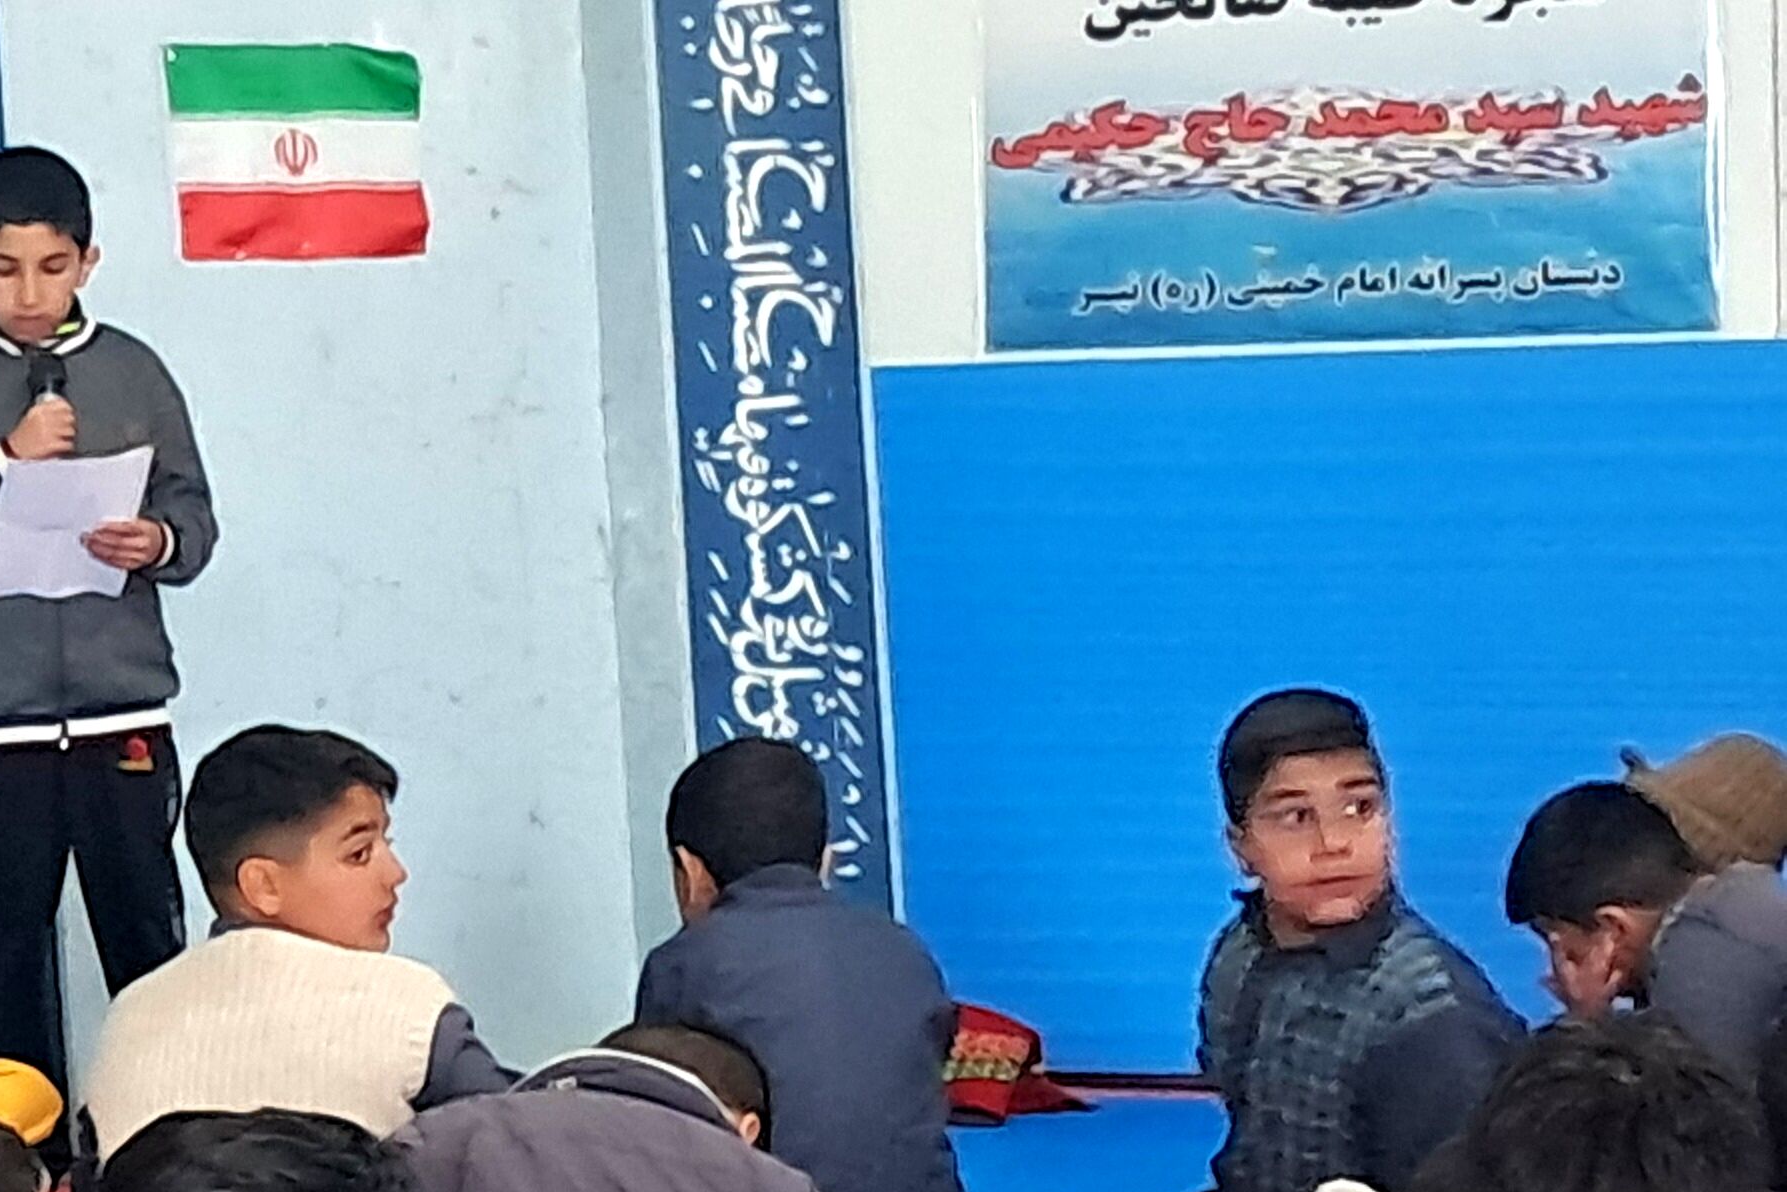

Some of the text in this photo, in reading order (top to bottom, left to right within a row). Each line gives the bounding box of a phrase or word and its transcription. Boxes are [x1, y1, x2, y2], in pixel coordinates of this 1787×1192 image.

[1183, 91, 1290, 163] حاج
[1309, 97, 1450, 140] محمد
[1464, 92, 1563, 145] سید
[1578, 73, 1708, 143] شهید
[1228, 273, 1324, 308] خمینی
[1334, 266, 1398, 302] امام
[1513, 256, 1624, 297] دبستان
